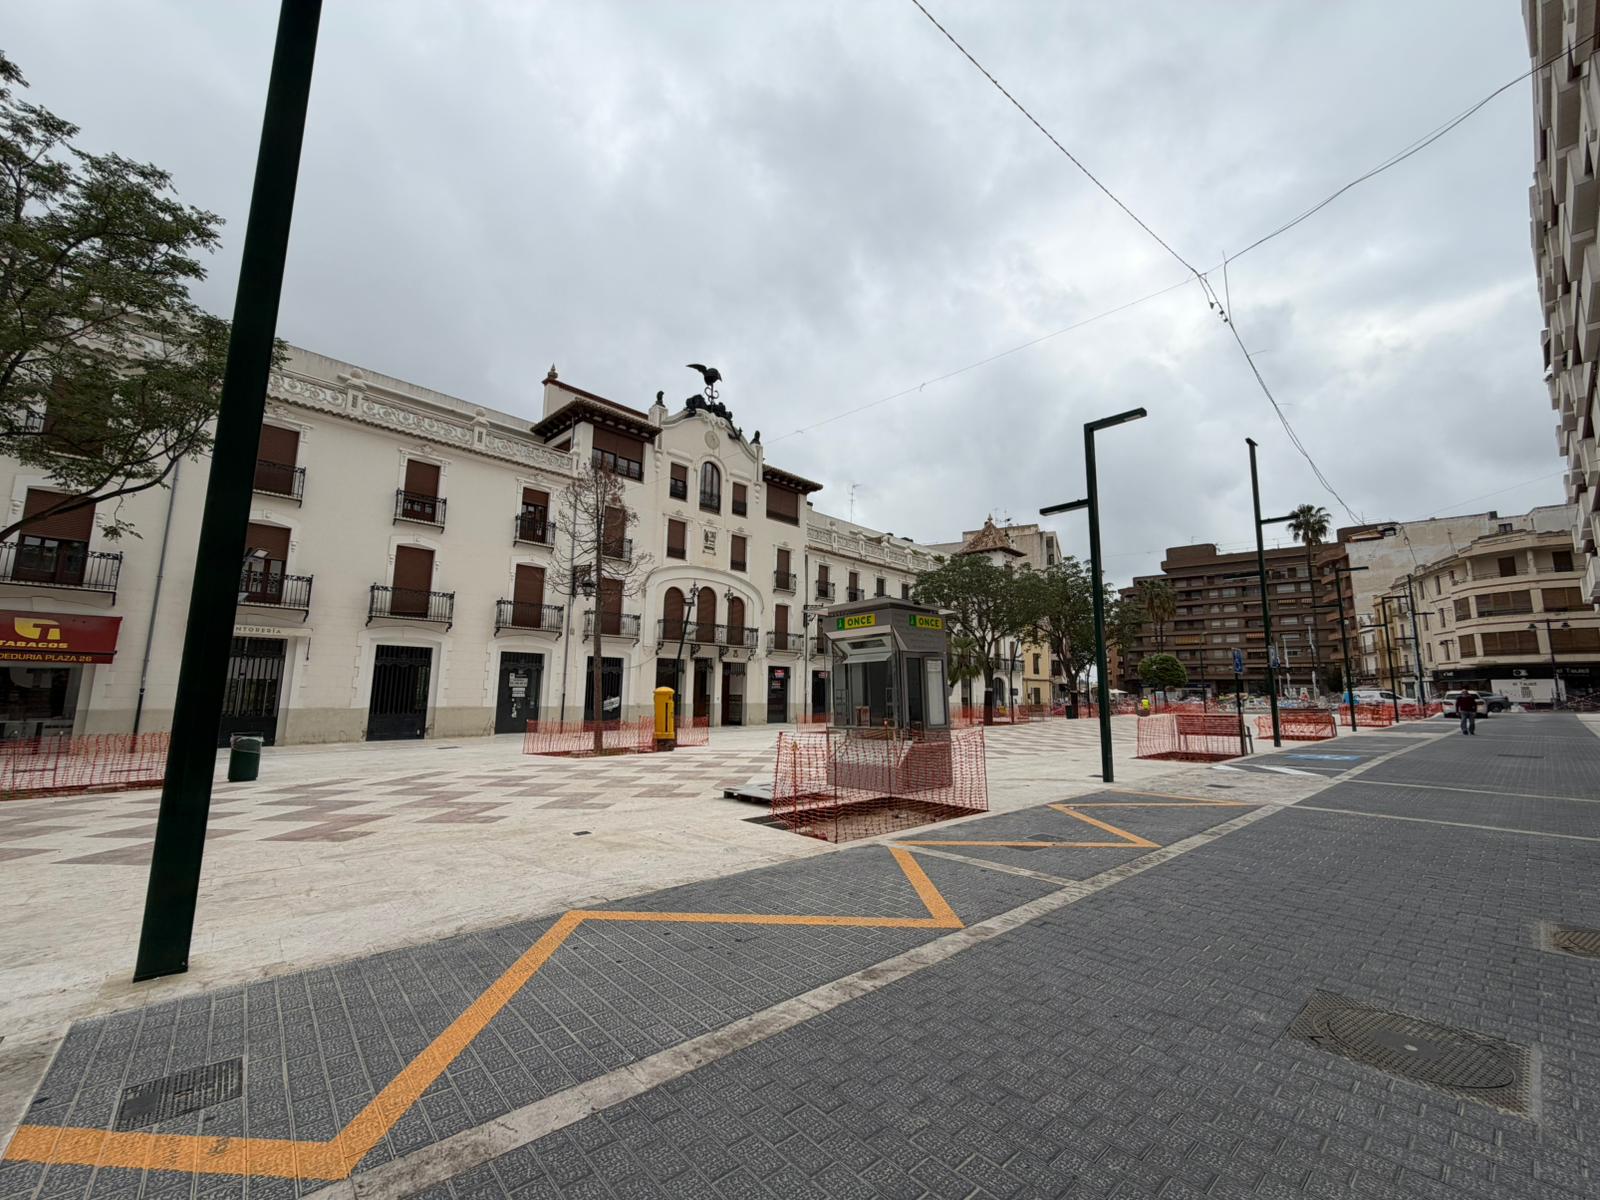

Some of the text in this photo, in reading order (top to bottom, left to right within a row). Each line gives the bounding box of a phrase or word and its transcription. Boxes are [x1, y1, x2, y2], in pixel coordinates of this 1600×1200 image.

[847, 615, 872, 626] ONCE
[918, 617, 940, 627] ONCE
[0, 640, 69, 649] TABACOS
